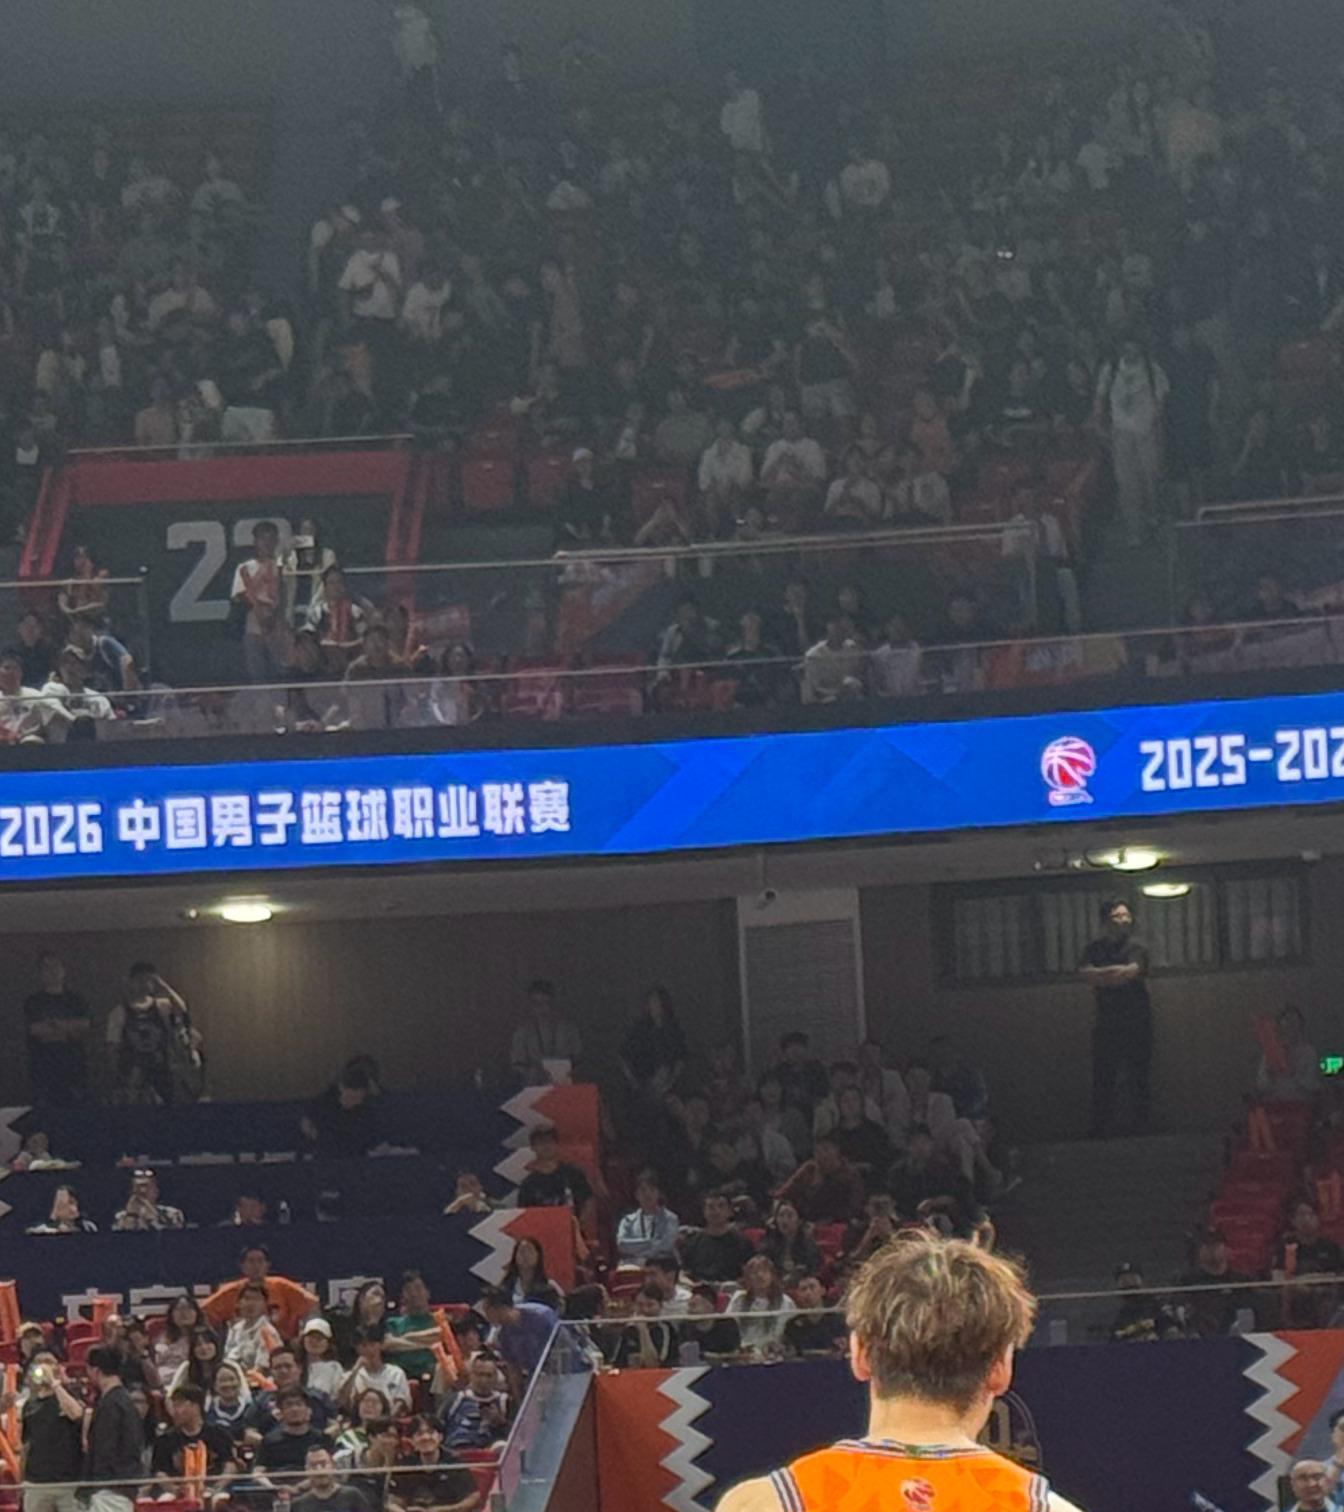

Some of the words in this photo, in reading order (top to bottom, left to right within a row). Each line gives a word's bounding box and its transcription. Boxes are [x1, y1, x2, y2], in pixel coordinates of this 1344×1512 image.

[118, 780, 570, 851] 中国男子篮球职业联赛
